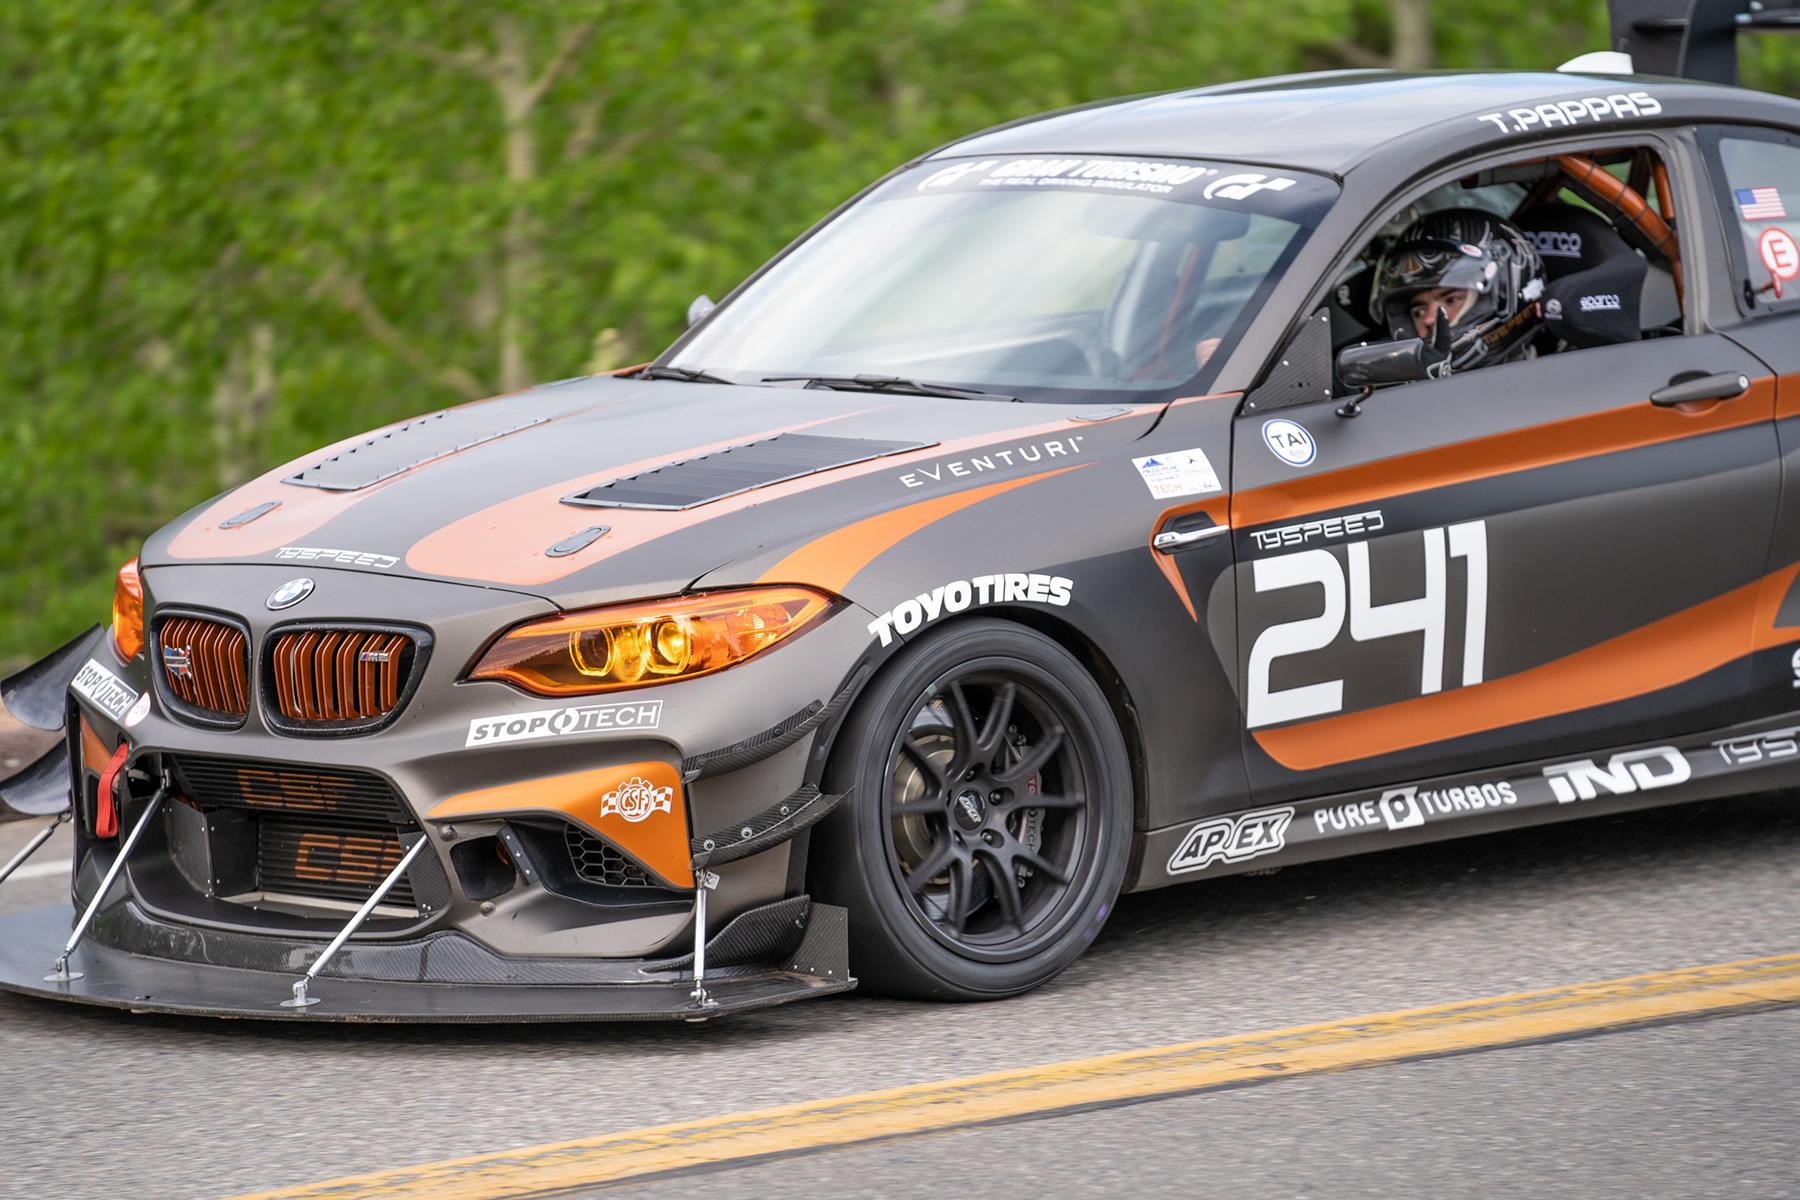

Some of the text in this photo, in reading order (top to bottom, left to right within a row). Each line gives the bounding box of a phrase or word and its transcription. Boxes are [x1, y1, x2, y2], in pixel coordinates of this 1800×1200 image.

[1478, 91, 1663, 134] T.PAPPAS
[990, 159, 1083, 178] GRAN
[1271, 431, 1307, 449] TAI
[867, 573, 1074, 648] TOYO TIRES
[1246, 519, 1488, 729] 241
[620, 788, 651, 812] CSF
[1313, 800, 1381, 834] PURE
[1418, 781, 1519, 815] TURBOS
[1174, 814, 1287, 865] APEX
